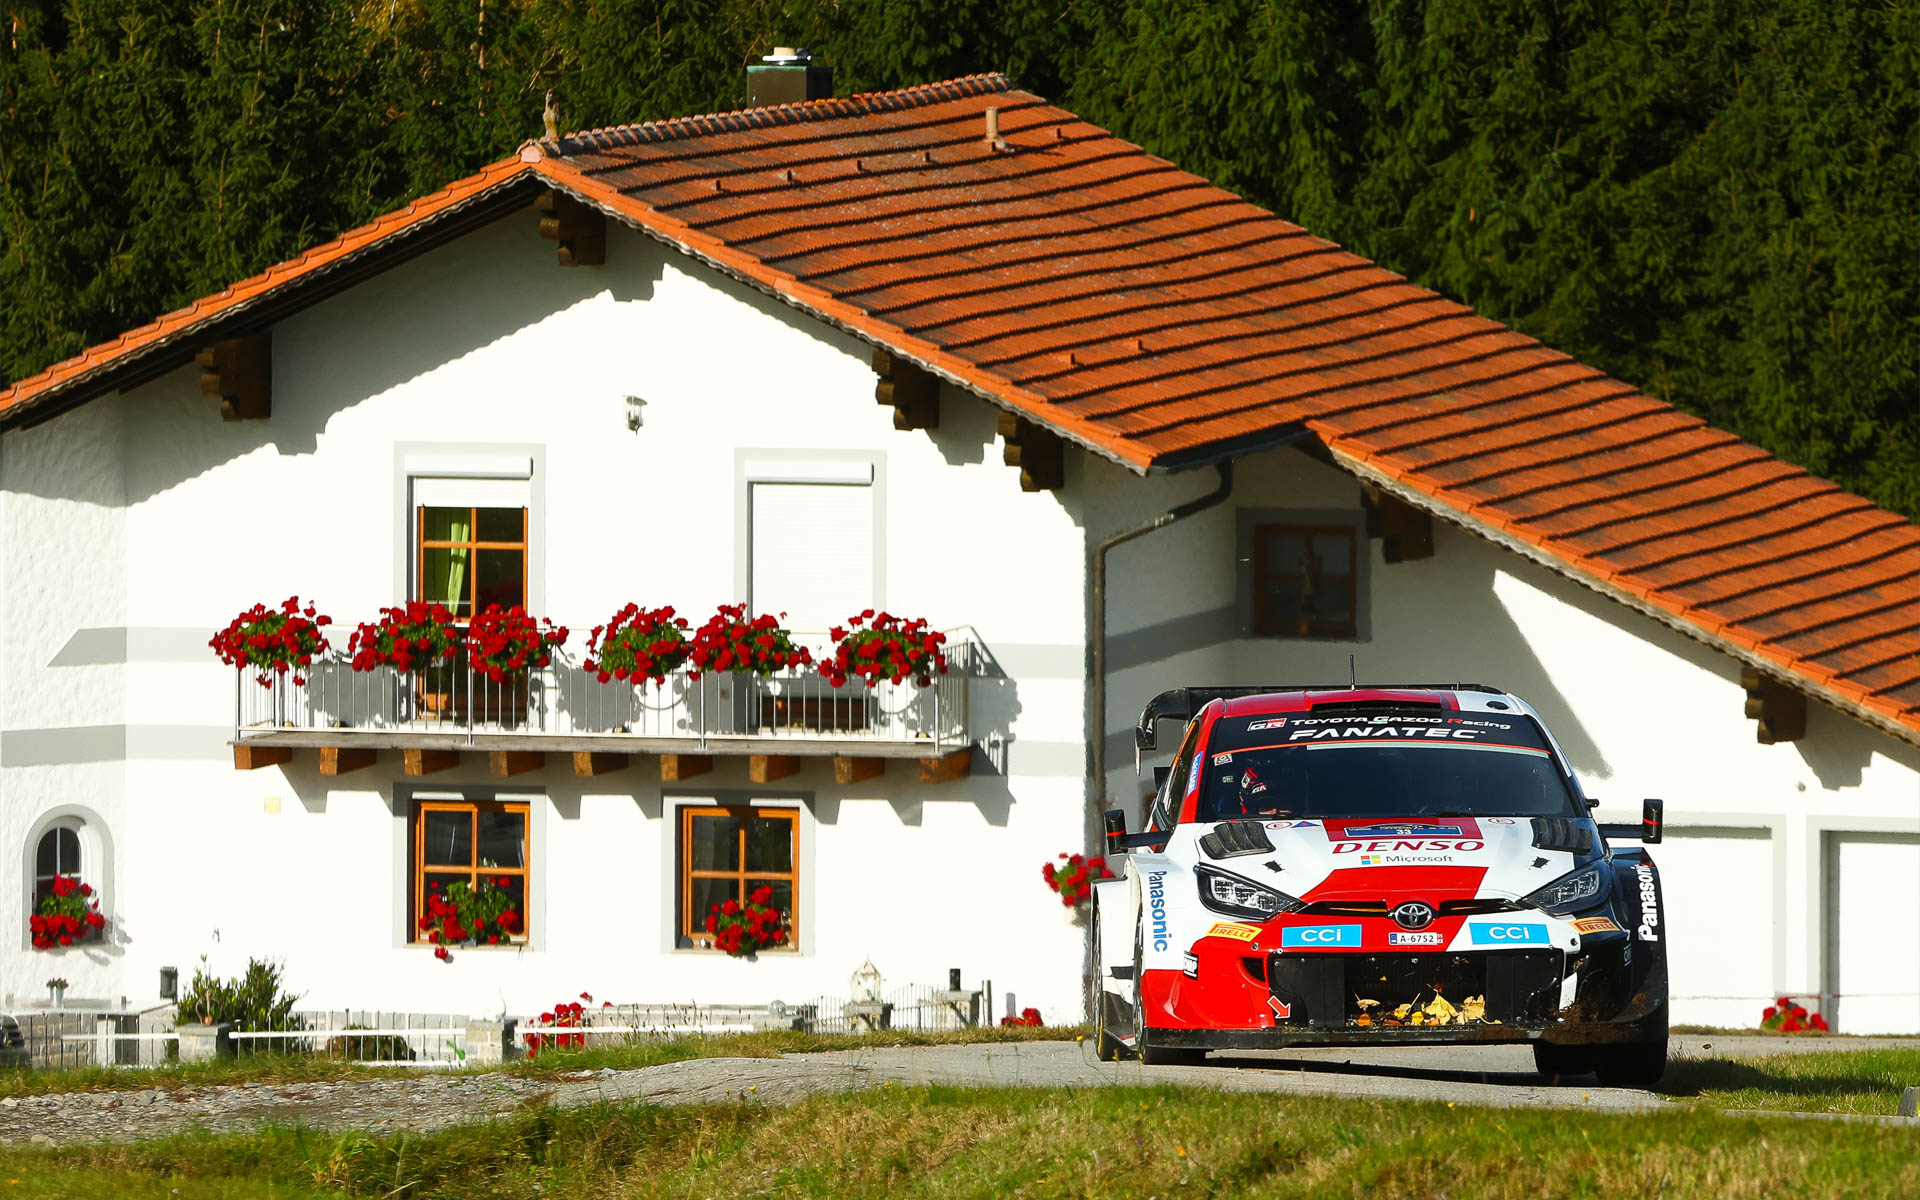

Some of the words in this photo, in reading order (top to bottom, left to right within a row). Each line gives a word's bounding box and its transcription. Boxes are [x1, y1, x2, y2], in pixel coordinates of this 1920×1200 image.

[1290, 717, 1368, 726] TOYOTA
[1372, 716, 1443, 724] GAZOO
[1447, 718, 1511, 730] Racing
[1288, 727, 1479, 741] FANATEC
[1332, 841, 1485, 854] DENSO
[1386, 855, 1453, 863] Microsoft
[1148, 871, 1172, 953] Panasonic
[1208, 923, 1256, 938] PIRELLI
[1574, 918, 1614, 932] PIRELLI
[1400, 935, 1434, 943] A-6752
